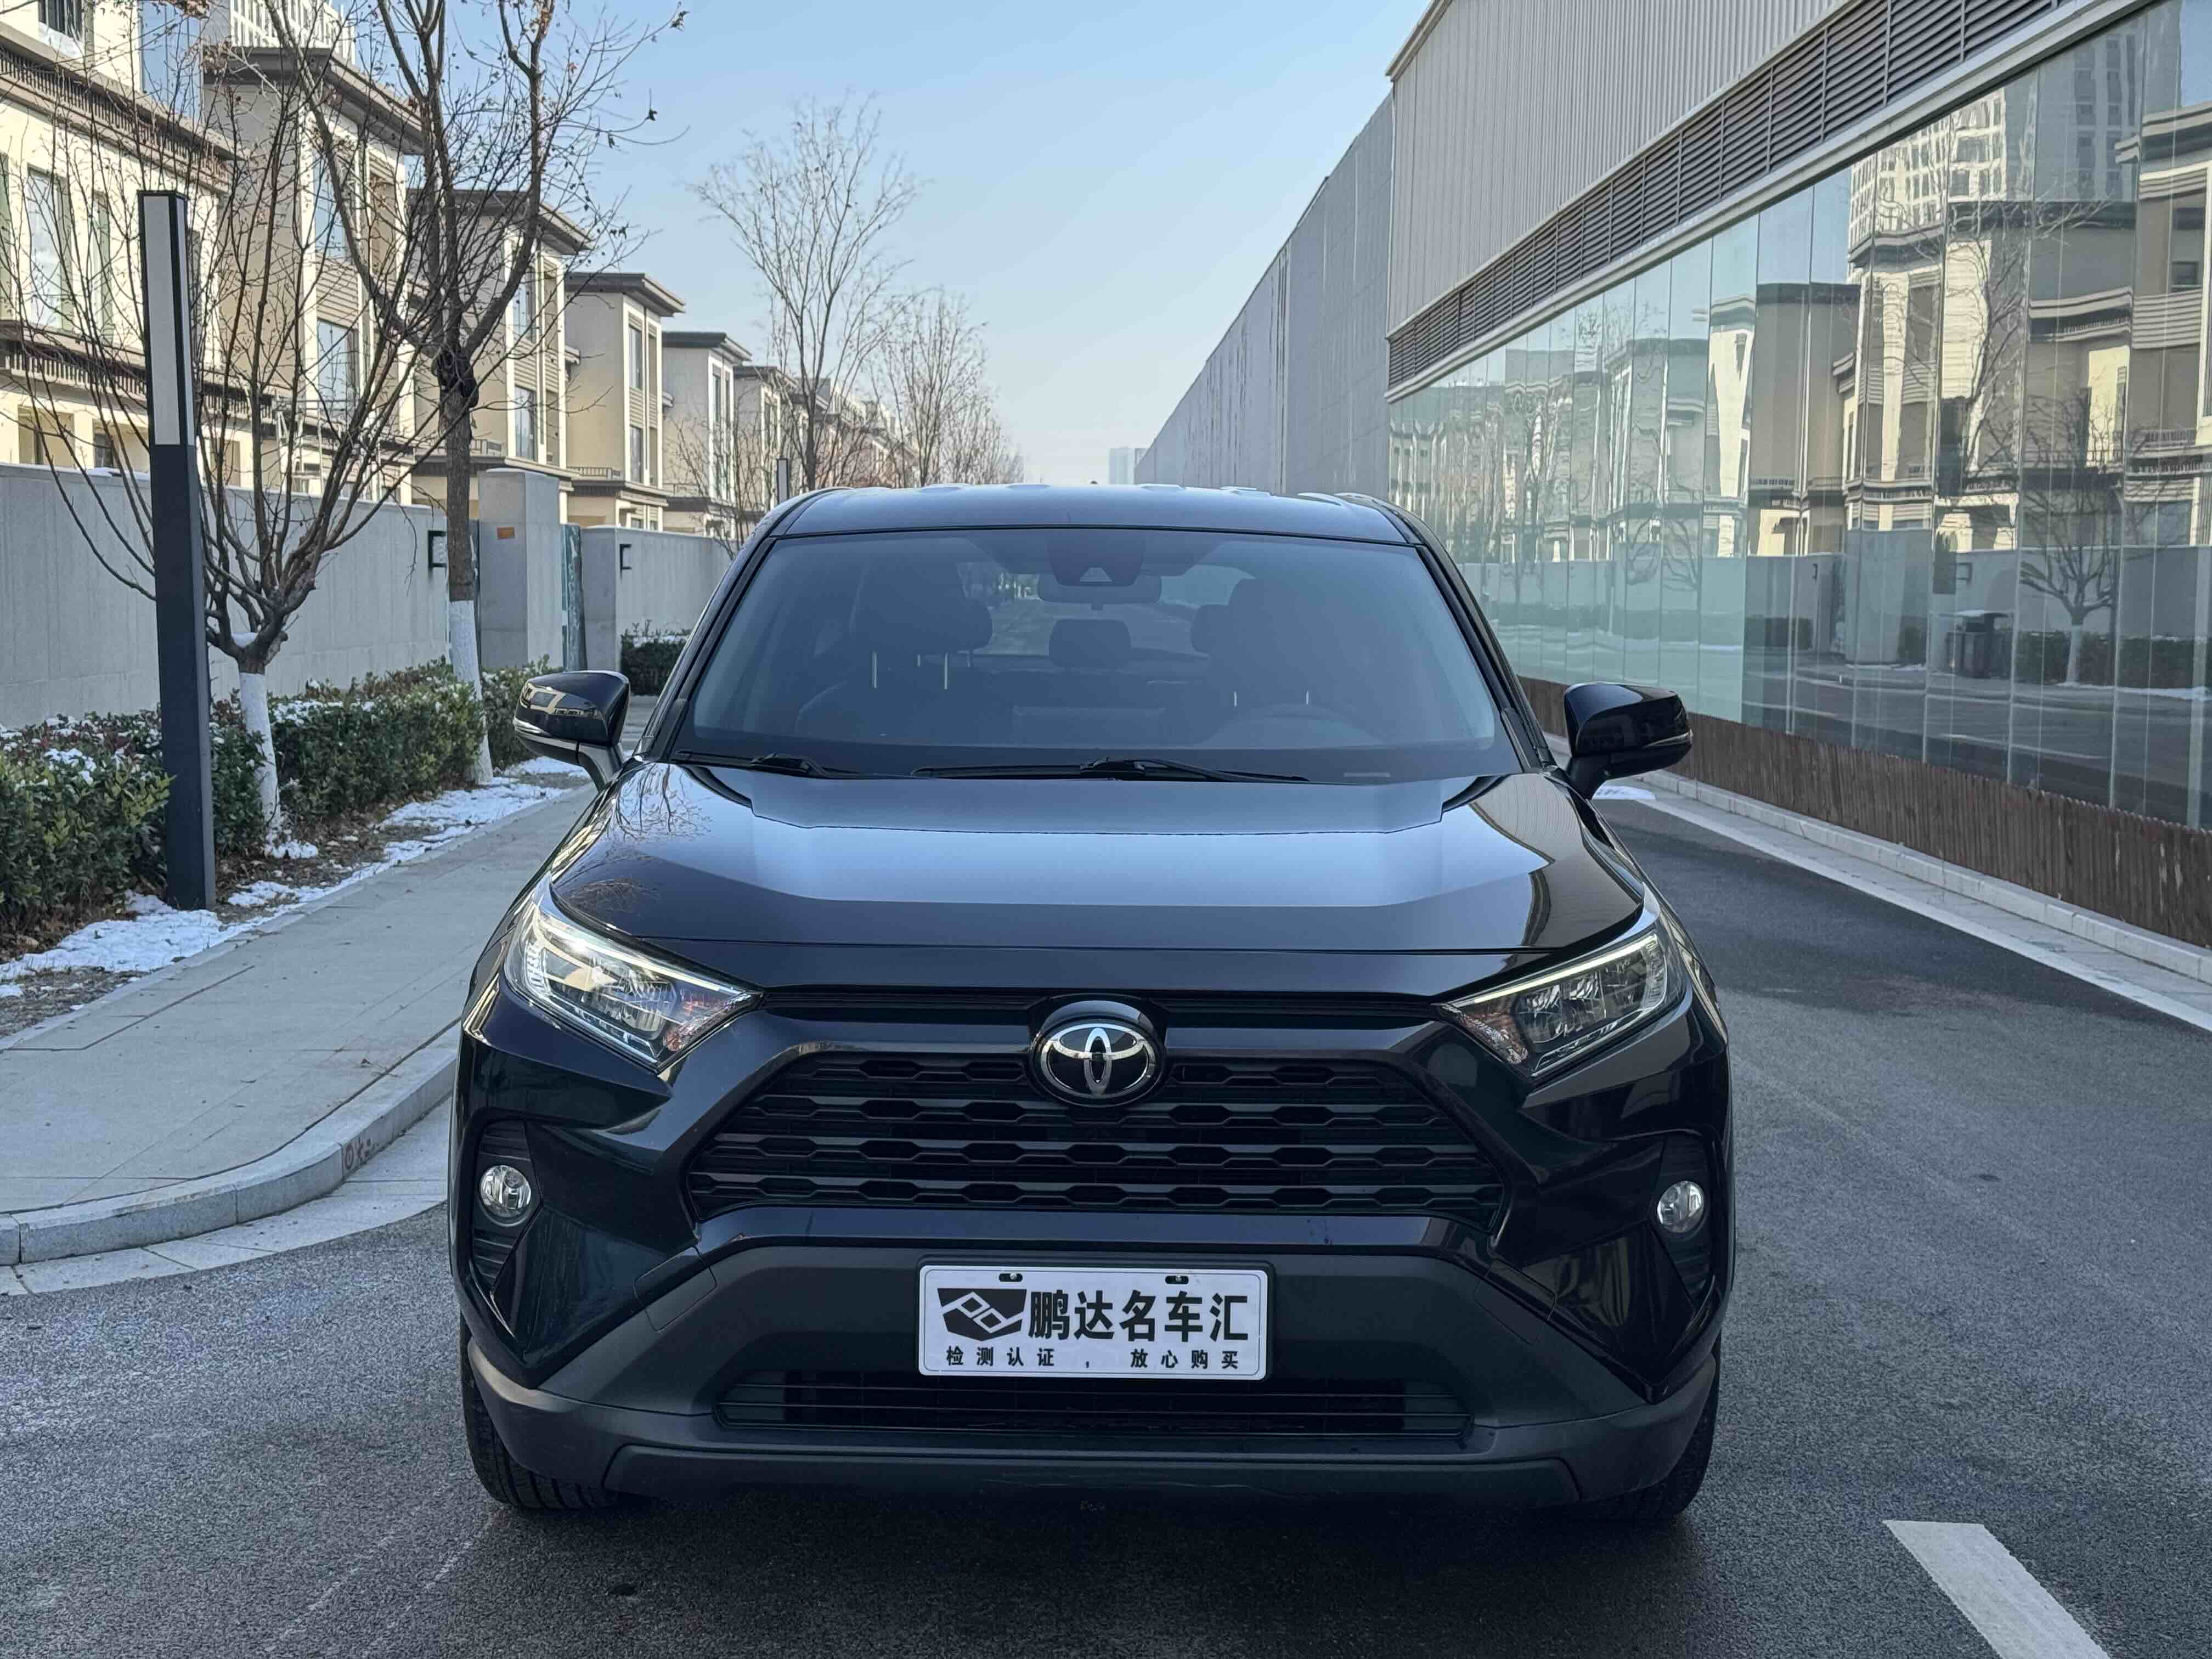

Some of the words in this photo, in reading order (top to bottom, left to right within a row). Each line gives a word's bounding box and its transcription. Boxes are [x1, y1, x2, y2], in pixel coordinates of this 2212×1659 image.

[1028, 1289, 1249, 1342] 鹏达名车汇
